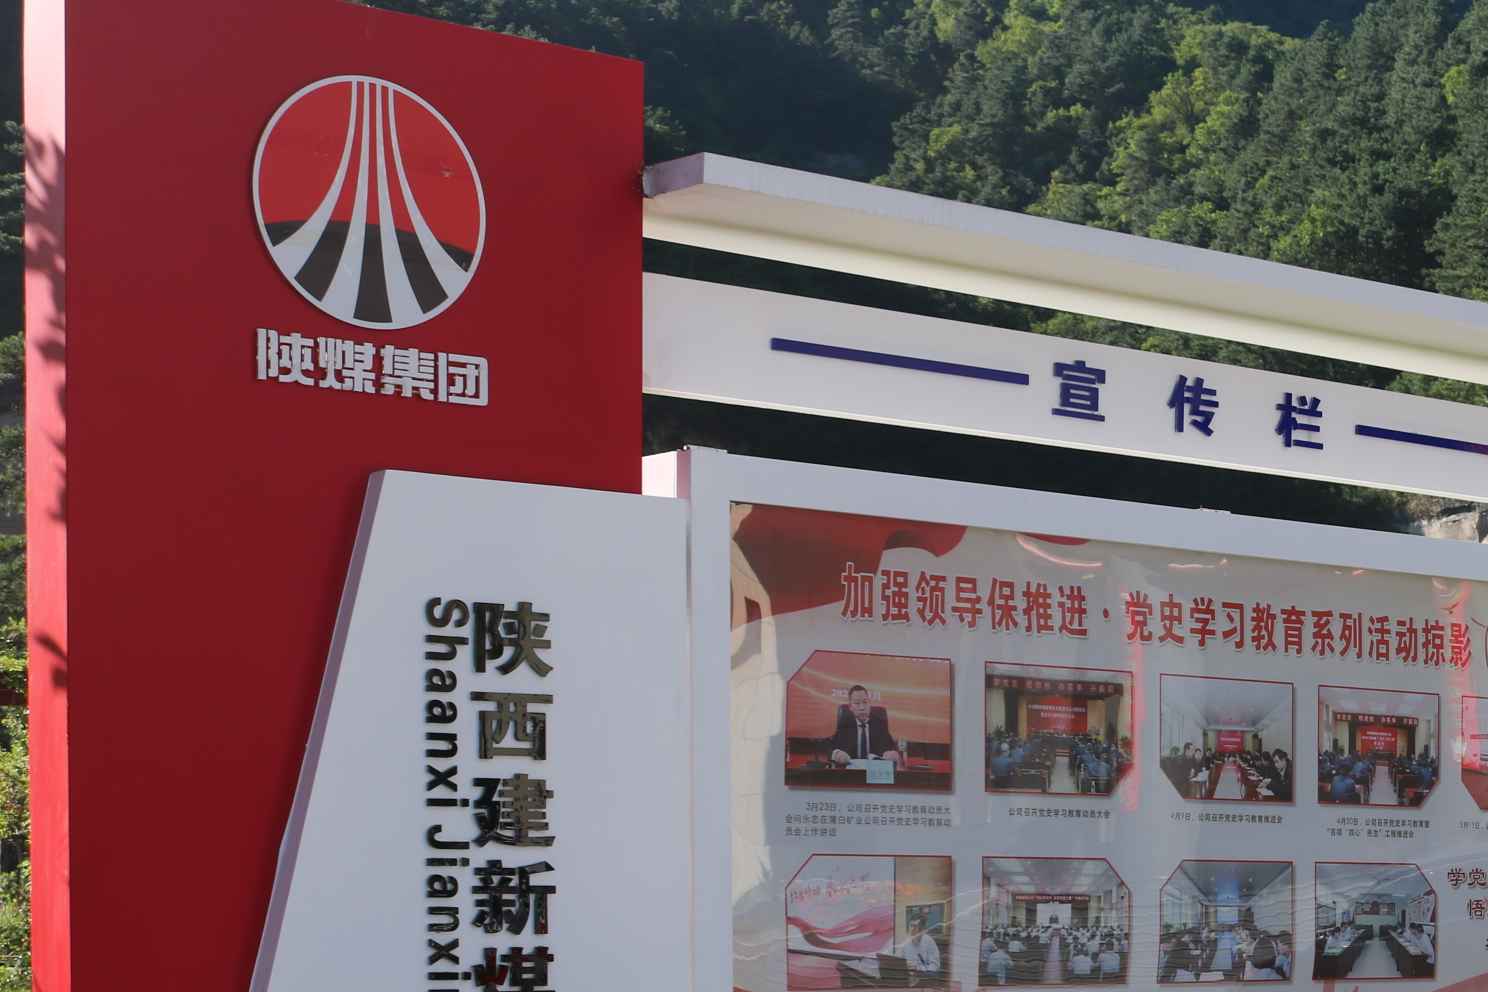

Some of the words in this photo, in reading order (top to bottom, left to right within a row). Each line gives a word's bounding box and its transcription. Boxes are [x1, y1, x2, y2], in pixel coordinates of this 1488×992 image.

[257, 328, 489, 407] 陕煤集团
[1052, 359, 1325, 451] 宣传栏
[425, 597, 471, 807] Shaanxi
